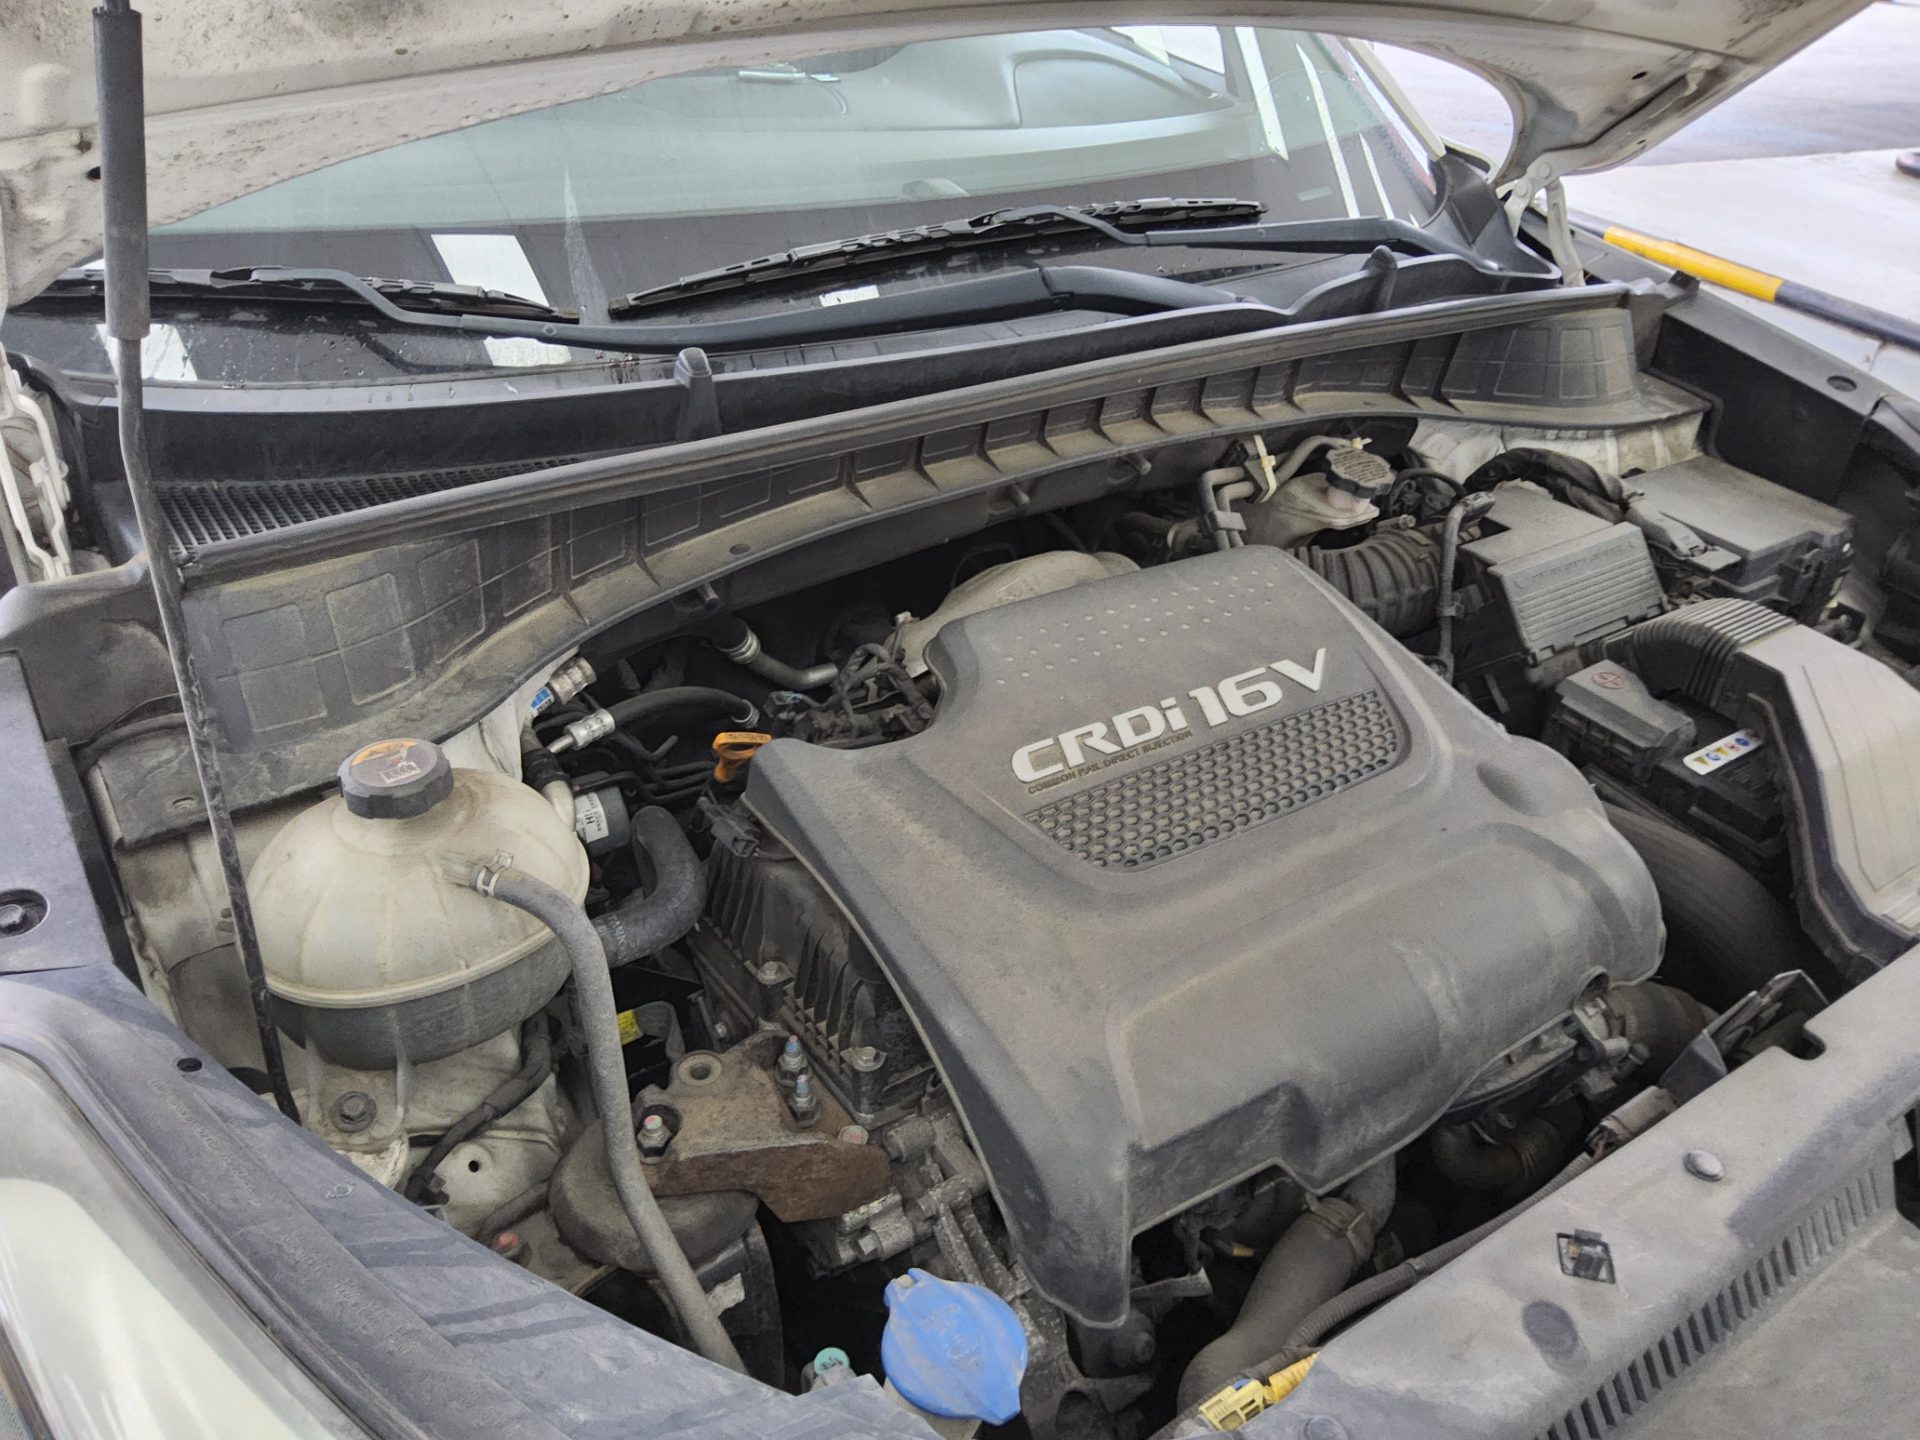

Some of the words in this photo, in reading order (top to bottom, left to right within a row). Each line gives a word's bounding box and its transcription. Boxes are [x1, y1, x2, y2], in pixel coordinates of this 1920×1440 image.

[1011, 697, 1188, 783] CRDi
[1189, 647, 1326, 727] 16V
[1027, 771, 1077, 795] COMMON
[1077, 761, 1102, 779] RAIL
[1102, 748, 1140, 767] DIRECT
[1142, 730, 1193, 754] INJECTION
